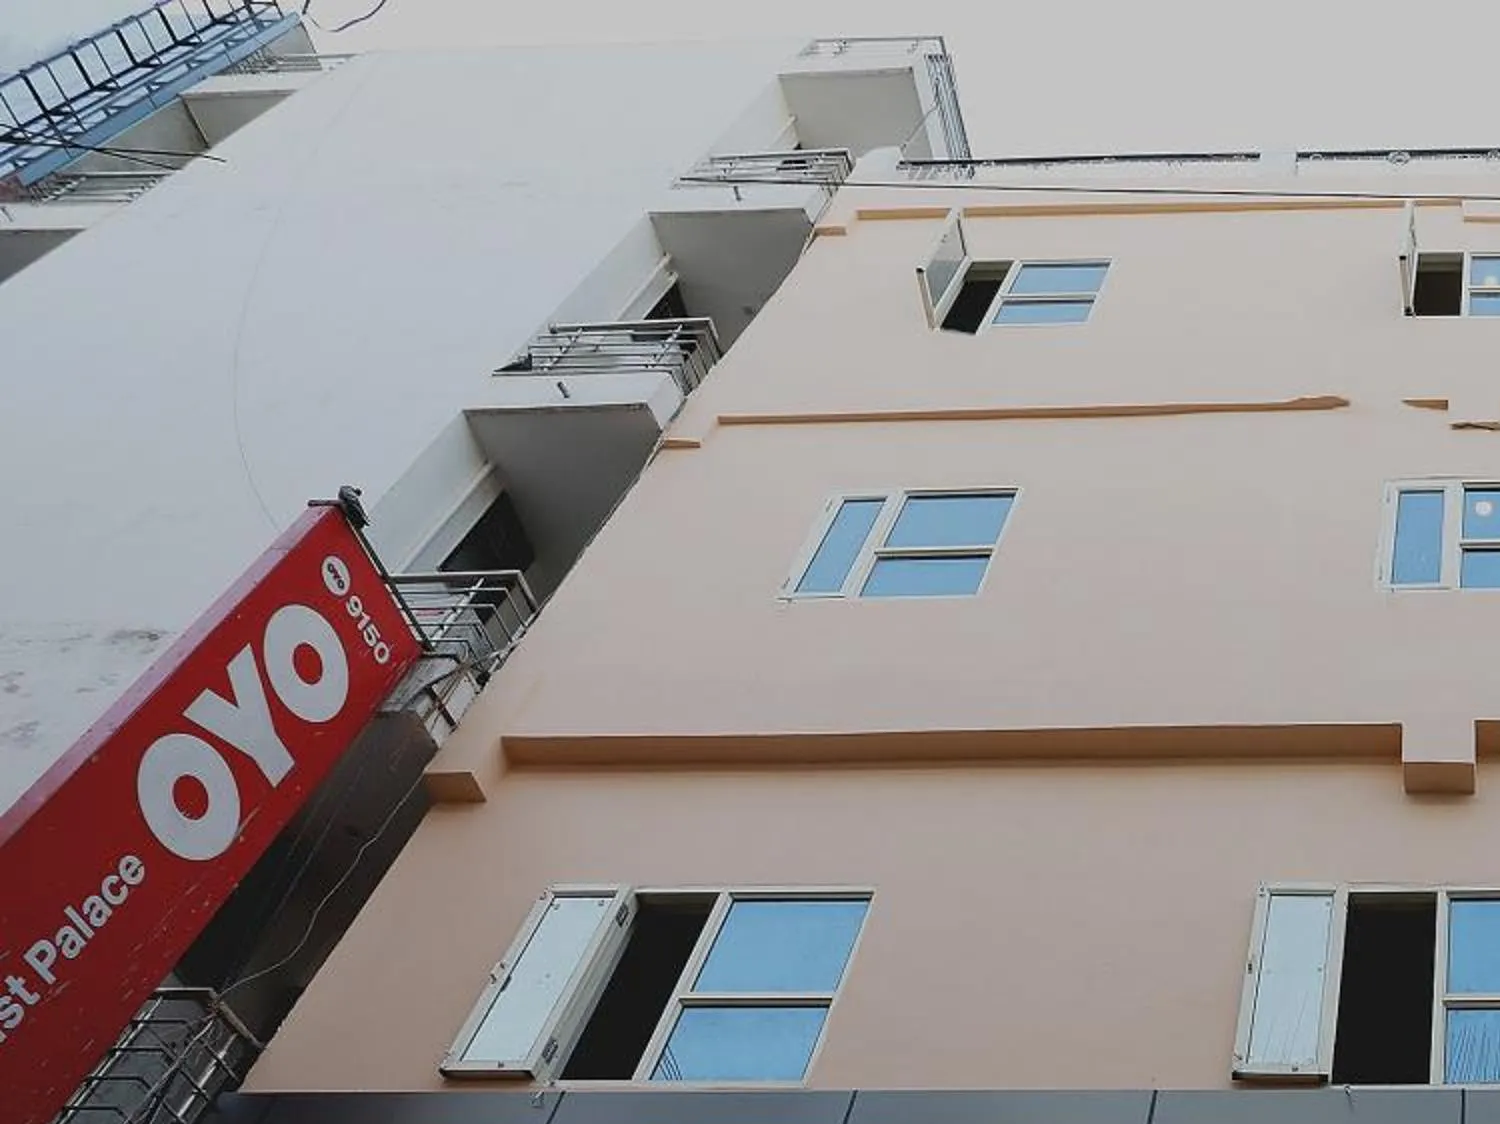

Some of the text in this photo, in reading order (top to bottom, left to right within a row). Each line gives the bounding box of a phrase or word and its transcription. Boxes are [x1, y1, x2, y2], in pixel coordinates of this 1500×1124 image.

[345, 595, 390, 665] 9150
[137, 603, 349, 861] OYO
[0, 854, 146, 1044] st Palace
